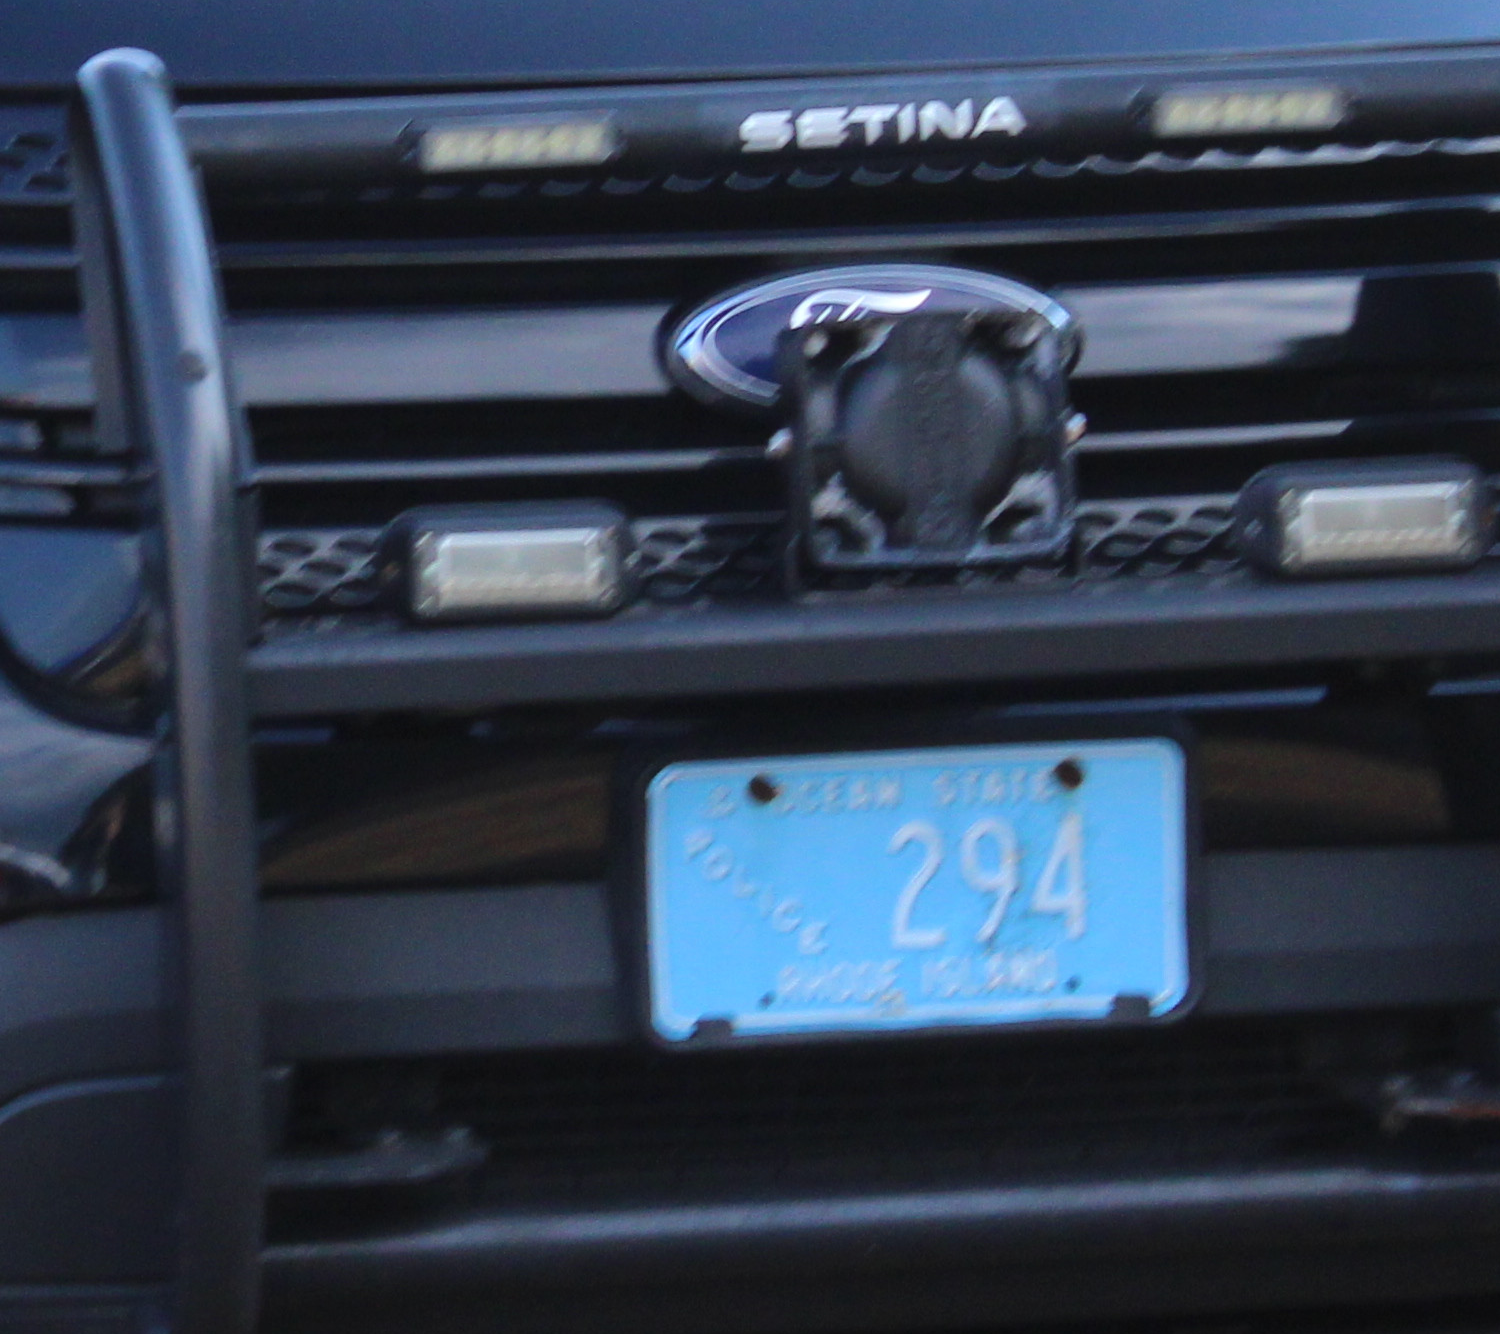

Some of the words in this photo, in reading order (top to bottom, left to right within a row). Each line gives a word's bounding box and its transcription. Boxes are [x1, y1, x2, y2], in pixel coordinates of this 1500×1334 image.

[738, 95, 1028, 153] SETINA
[684, 825, 830, 956] POLICE
[886, 812, 1088, 952] 294
